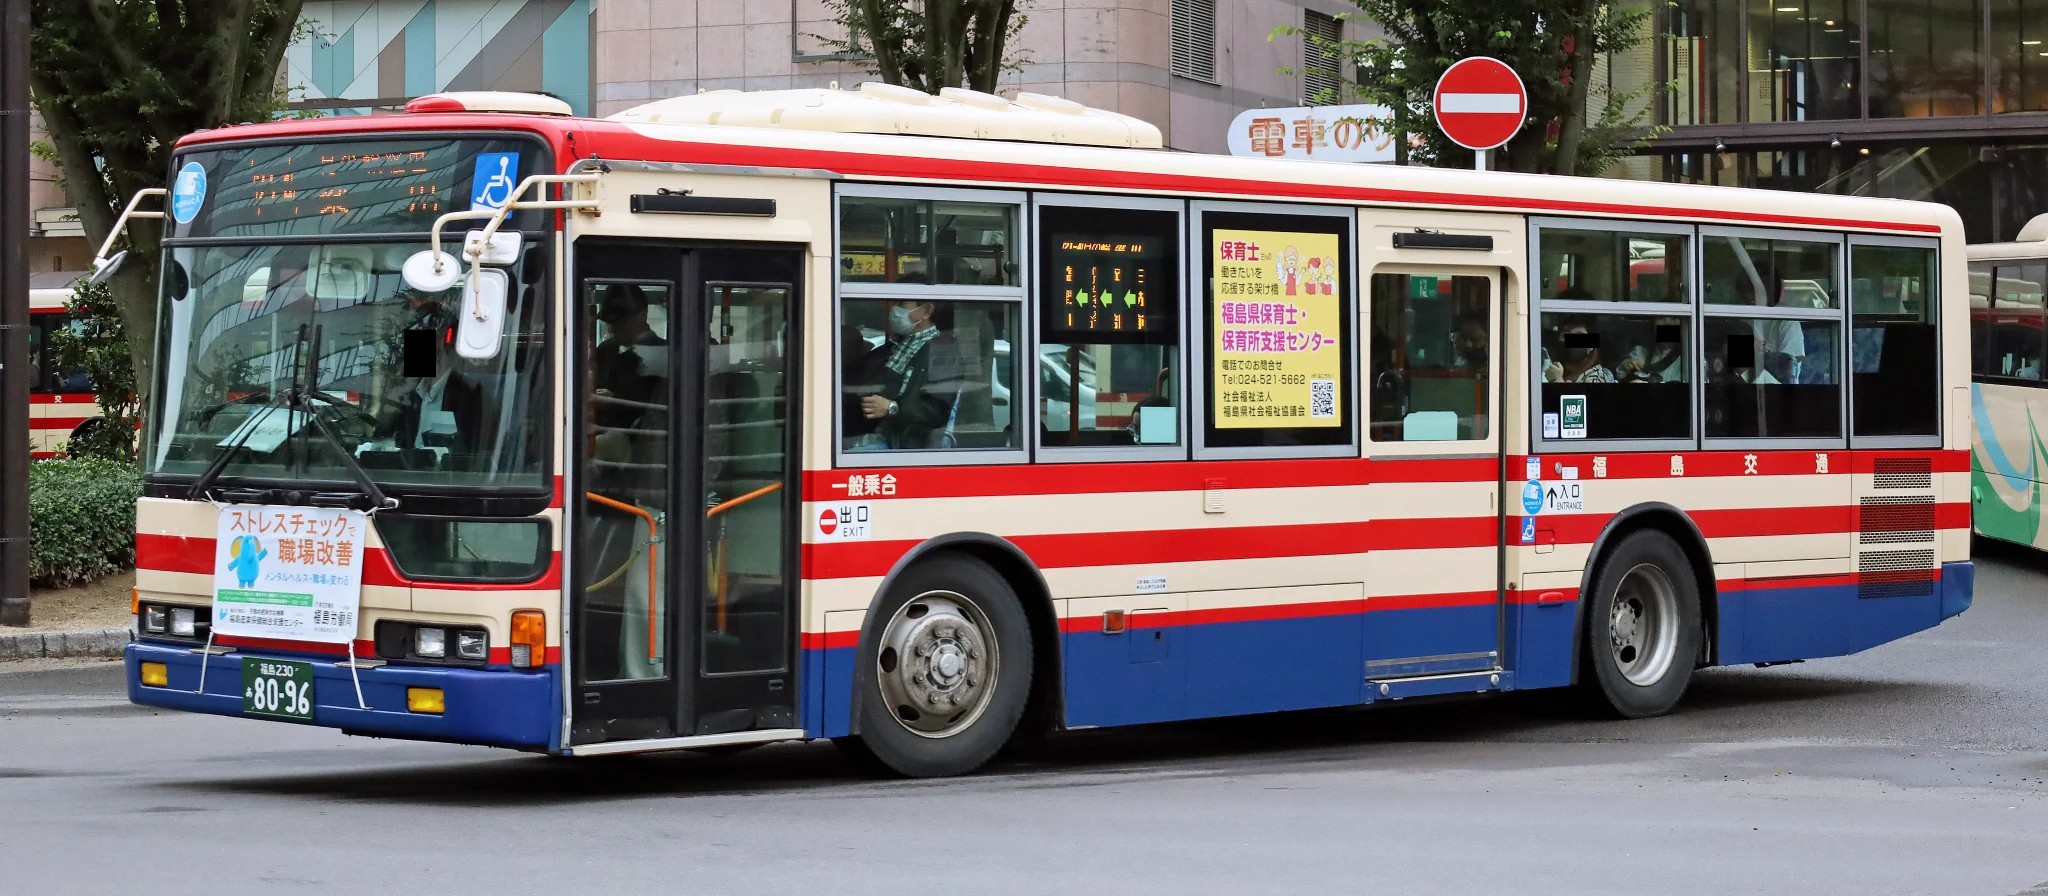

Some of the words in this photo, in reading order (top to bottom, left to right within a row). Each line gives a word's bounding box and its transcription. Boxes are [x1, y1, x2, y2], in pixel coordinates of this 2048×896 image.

[1221, 265, 1262, 279] 働きたいを
[1221, 282, 1279, 295] 応援する架け橋
[1221, 329, 1335, 352] 保育所支援センター
[1222, 359, 1283, 371] 電話でのお問合せ
[1222, 374, 1306, 385] Tel:024-521-5662
[1223, 391, 1273, 402] 社会福祉法人
[1223, 405, 1306, 417] 福島県社会福祉協議会
[1565, 404, 1582, 417] NBA
[831, 473, 897, 496] 一般乗合
[1560, 484, 1580, 499] 入口
[1556, 501, 1583, 511] ENTRANCE
[840, 505, 868, 523] 出口
[843, 526, 864, 537] EXIT
[278, 538, 354, 566] 職場改善
[254, 676, 310, 715] 80-96
